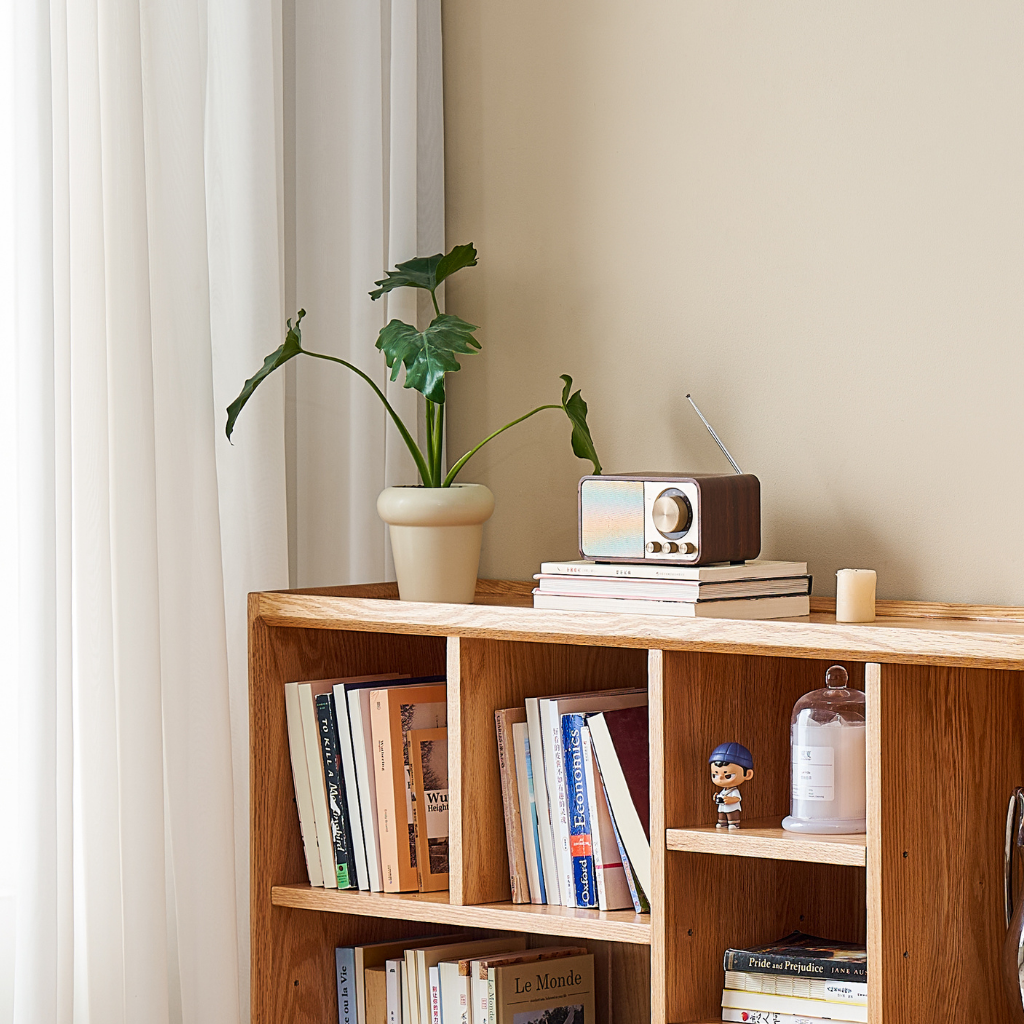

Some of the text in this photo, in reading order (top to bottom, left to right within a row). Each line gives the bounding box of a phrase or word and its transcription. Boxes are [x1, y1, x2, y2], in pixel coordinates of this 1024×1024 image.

[321, 718, 329, 733] TO
[323, 737, 333, 766] KILL
[571, 728, 587, 829] Economics
[578, 859, 590, 903] Oxford
[748, 957, 771, 969] Pride
[772, 962, 783, 970] and
[784, 960, 824, 974] Prejudice
[831, 967, 850, 975] JANE
[488, 979, 494, 990] Le
[514, 969, 582, 994] Le Monde
[341, 987, 348, 997] la
[343, 1000, 350, 1014] ou
